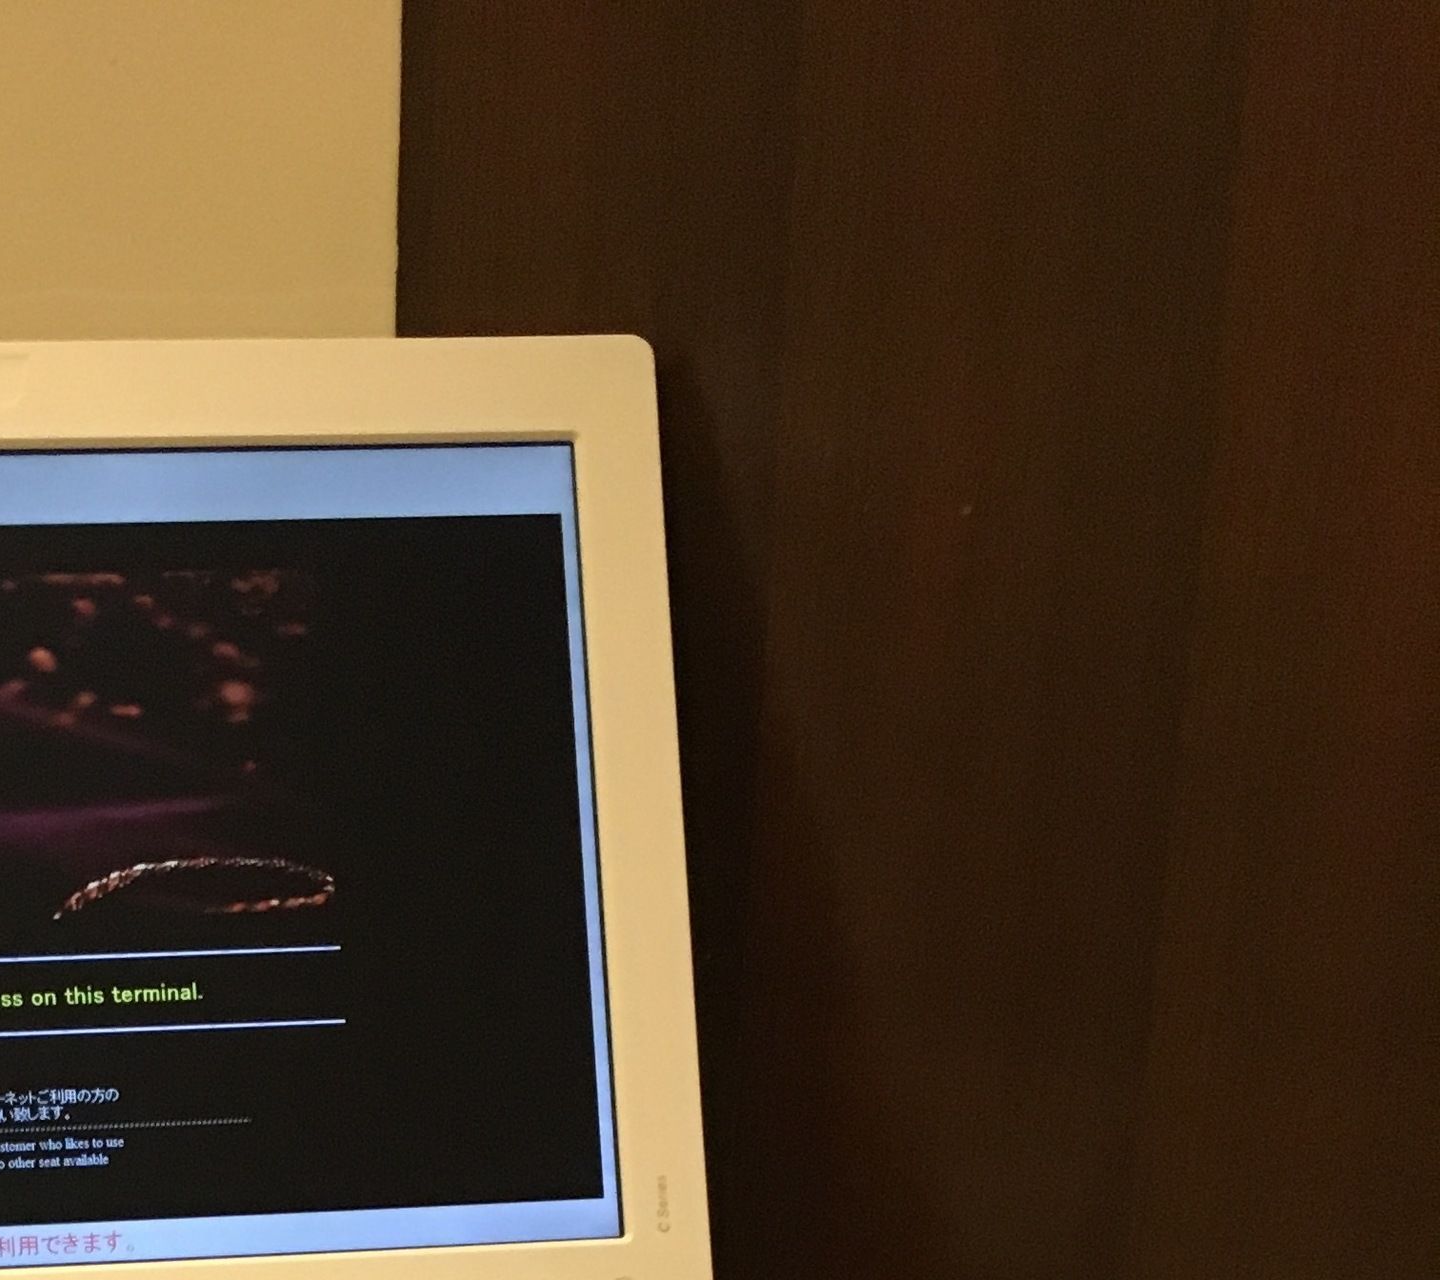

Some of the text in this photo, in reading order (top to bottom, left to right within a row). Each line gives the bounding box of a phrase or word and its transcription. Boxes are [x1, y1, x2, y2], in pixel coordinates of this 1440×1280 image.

[31, 992, 57, 1006] on
[64, 986, 104, 1005] this
[111, 982, 204, 1003] terminal.
[39, 1138, 63, 1150] who
[65, 1137, 90, 1149] likes
[92, 1138, 104, 1148] to
[106, 1137, 124, 1148] use
[8, 1156, 35, 1168] other
[39, 1155, 61, 1167] seat
[63, 1154, 109, 1167] available
